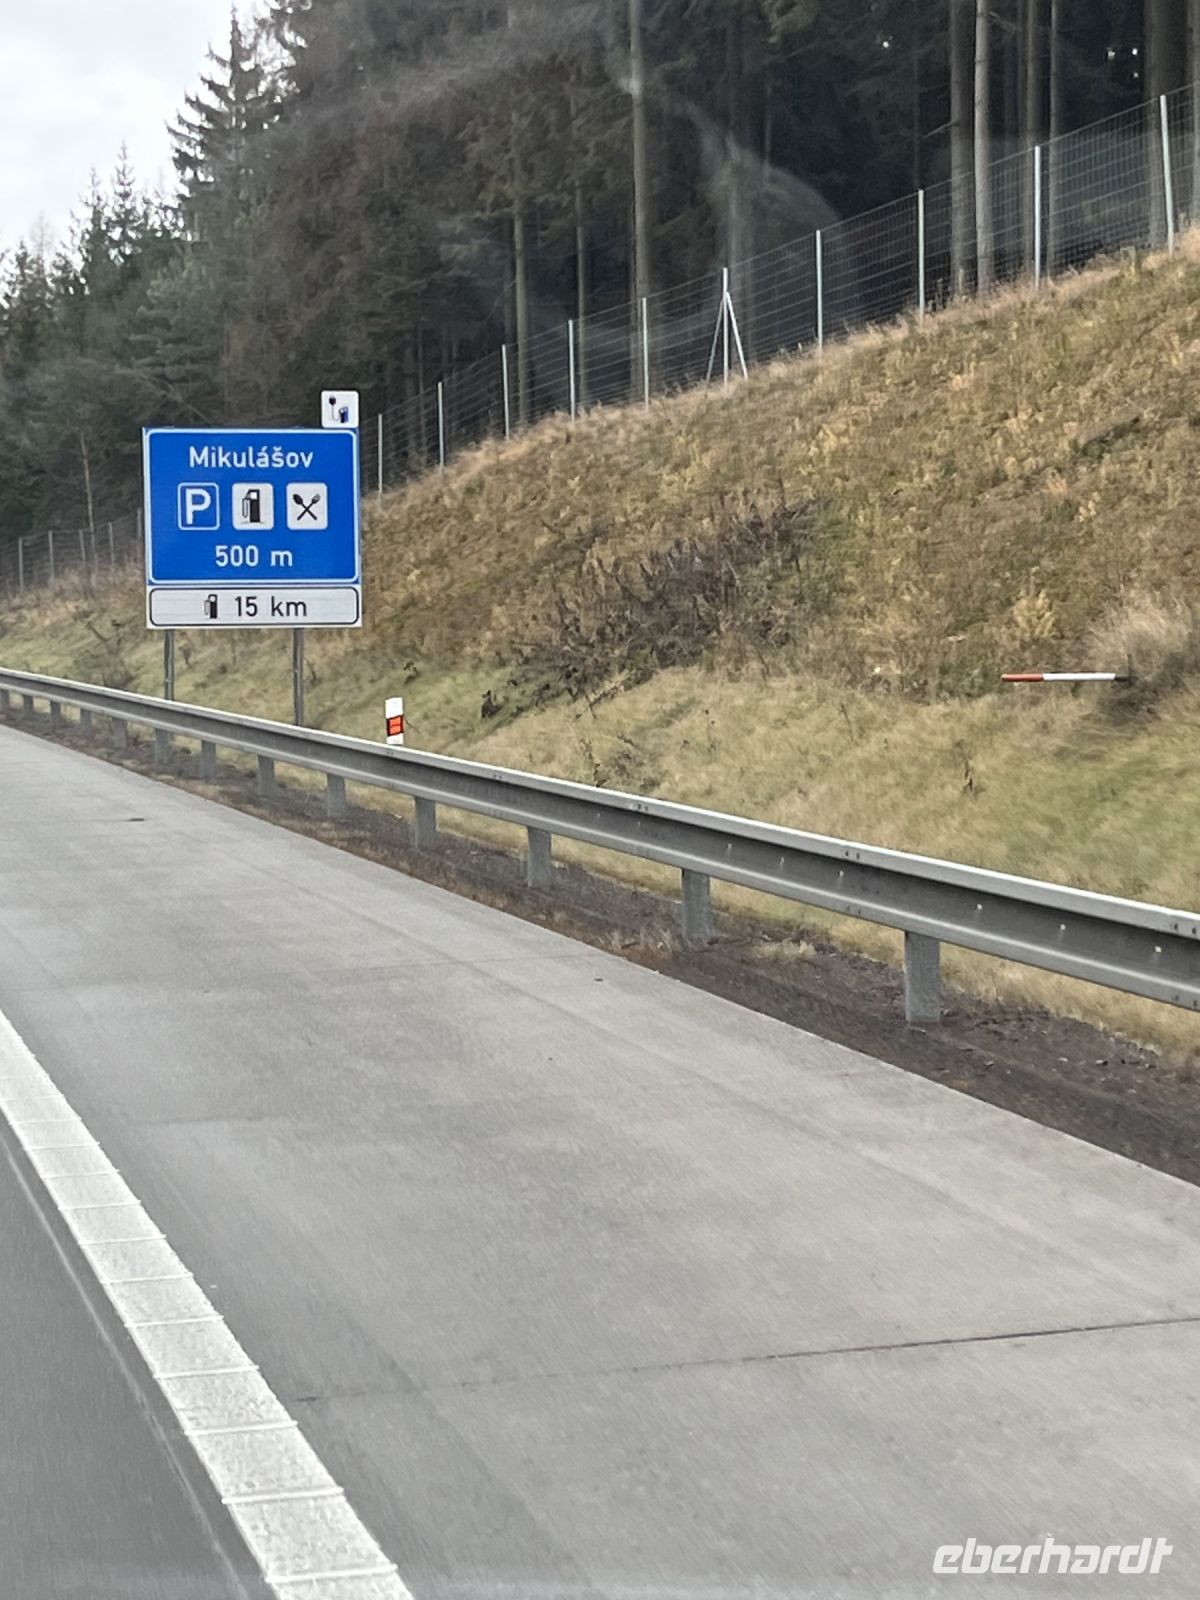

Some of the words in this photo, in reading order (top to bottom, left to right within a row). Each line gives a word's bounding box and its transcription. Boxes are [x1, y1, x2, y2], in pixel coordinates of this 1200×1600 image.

[188, 446, 314, 469] Mikulášov
[185, 488, 212, 525] P
[215, 545, 259, 567] 500
[270, 549, 293, 567] m
[234, 596, 258, 617] 15
[271, 595, 307, 617] km
